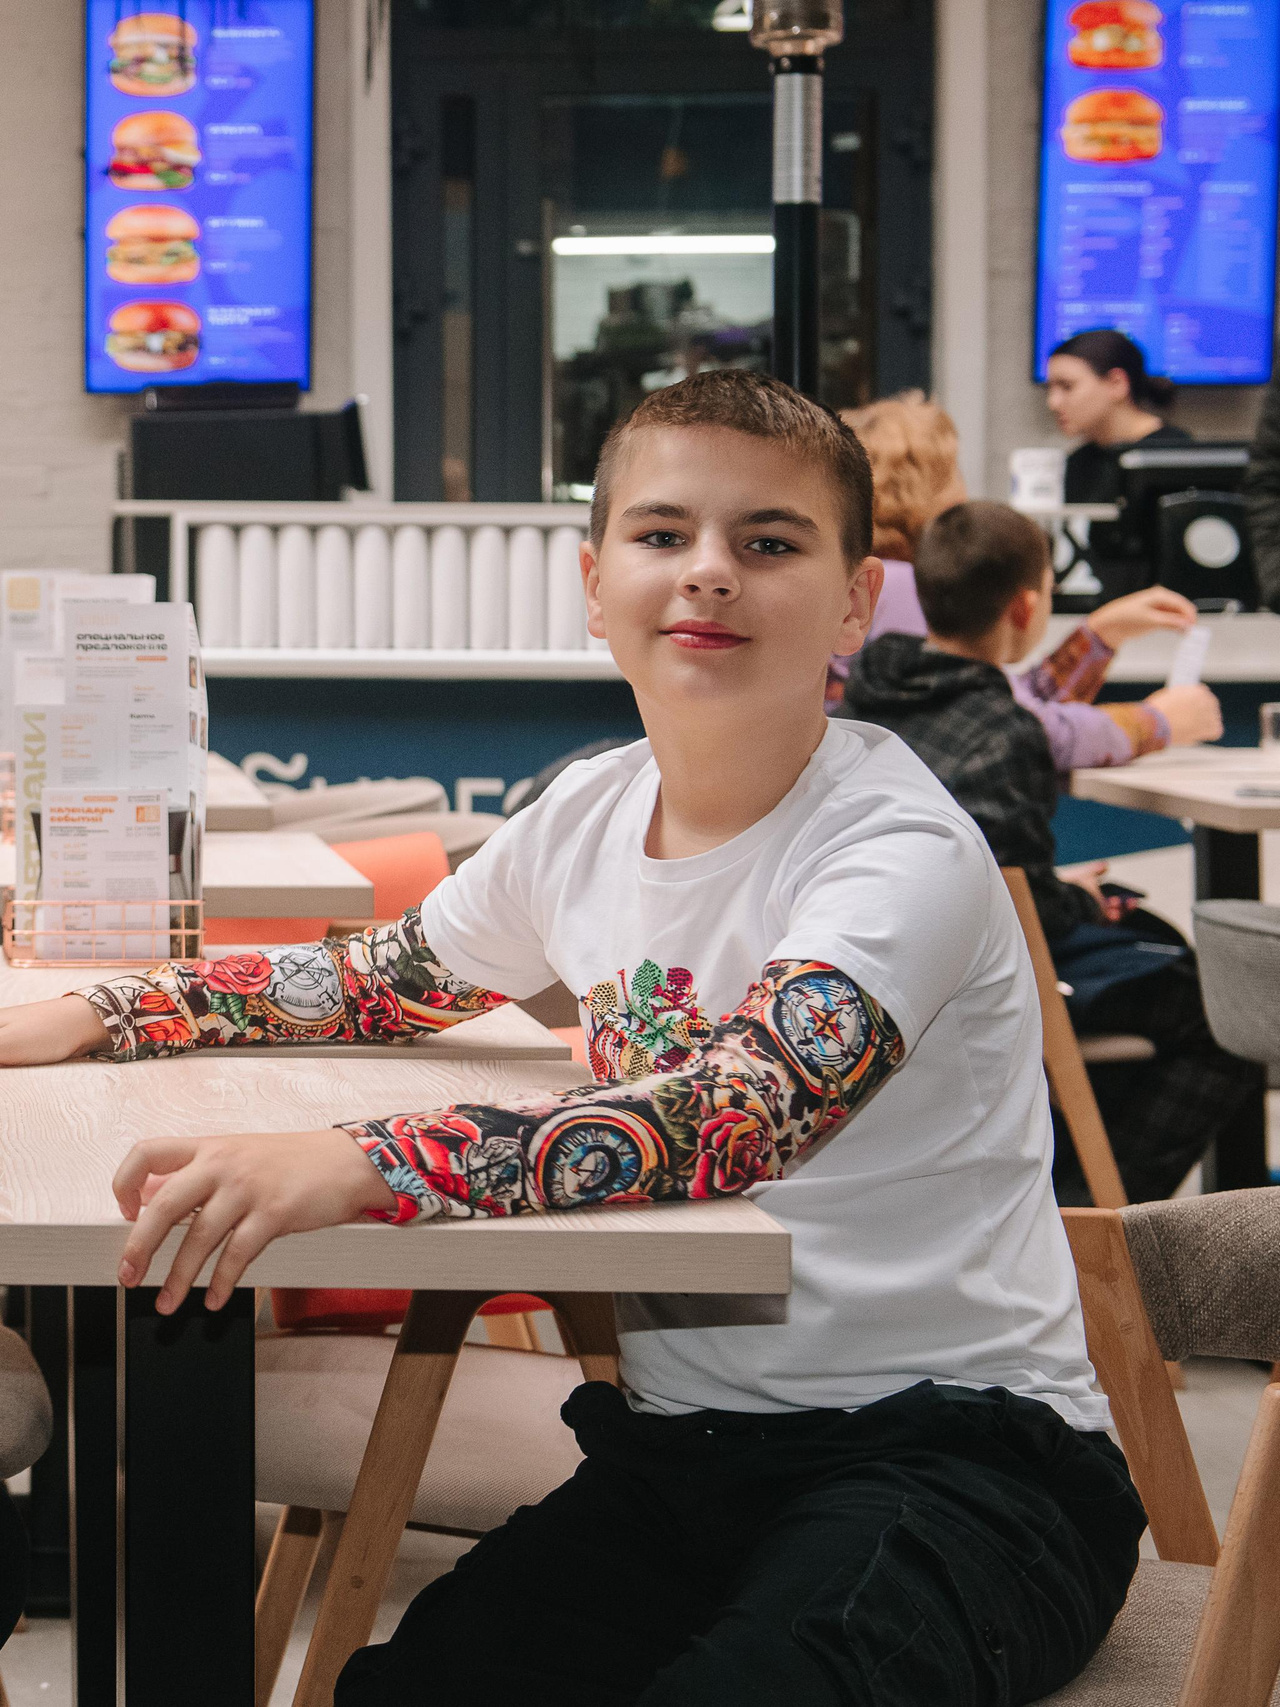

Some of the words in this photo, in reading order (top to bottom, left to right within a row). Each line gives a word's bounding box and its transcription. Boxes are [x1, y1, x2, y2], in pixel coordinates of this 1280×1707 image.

[75, 632, 166, 642] специальное
[75, 643, 168, 652] предложение
[49, 806, 115, 815] календарь
